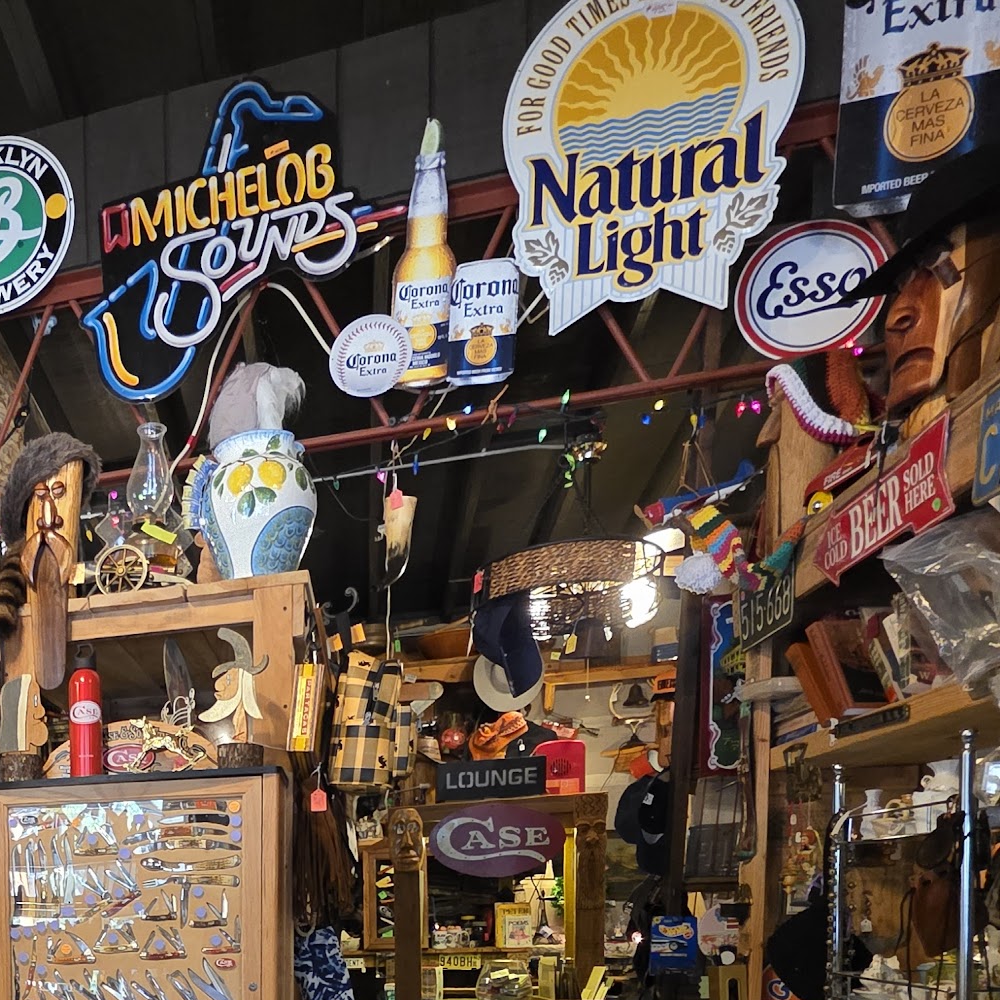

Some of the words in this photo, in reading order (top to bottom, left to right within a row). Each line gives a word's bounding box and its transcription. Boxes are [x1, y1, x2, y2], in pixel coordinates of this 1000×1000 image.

[527, 35, 572, 90] GOOD
[920, 88, 940, 102] LA
[516, 96, 546, 137] FOR
[896, 97, 964, 122] CERVEZA
[911, 115, 945, 133] MAS
[910, 129, 945, 147] FINA
[530, 112, 766, 228] Natural
[861, 178, 901, 195] IMPORTED
[576, 207, 708, 288] Light
[399, 282, 449, 302] Corona
[451, 278, 519, 309] Corona
[757, 260, 869, 321] Esso
[411, 299, 440, 310] Extra
[464, 303, 503, 317] Extra
[346, 351, 397, 371] Corona
[359, 367, 387, 377] Extra
[903, 451, 934, 492] SOLD
[904, 474, 935, 514] HERE
[849, 475, 902, 559] BEER
[826, 522, 842, 548] ICE
[824, 542, 848, 571] COLD
[72, 705, 99, 719] CASE
[107, 748, 144, 767] CAS
[446, 767, 538, 790] LOUNGE
[436, 817, 550, 863] CASE
